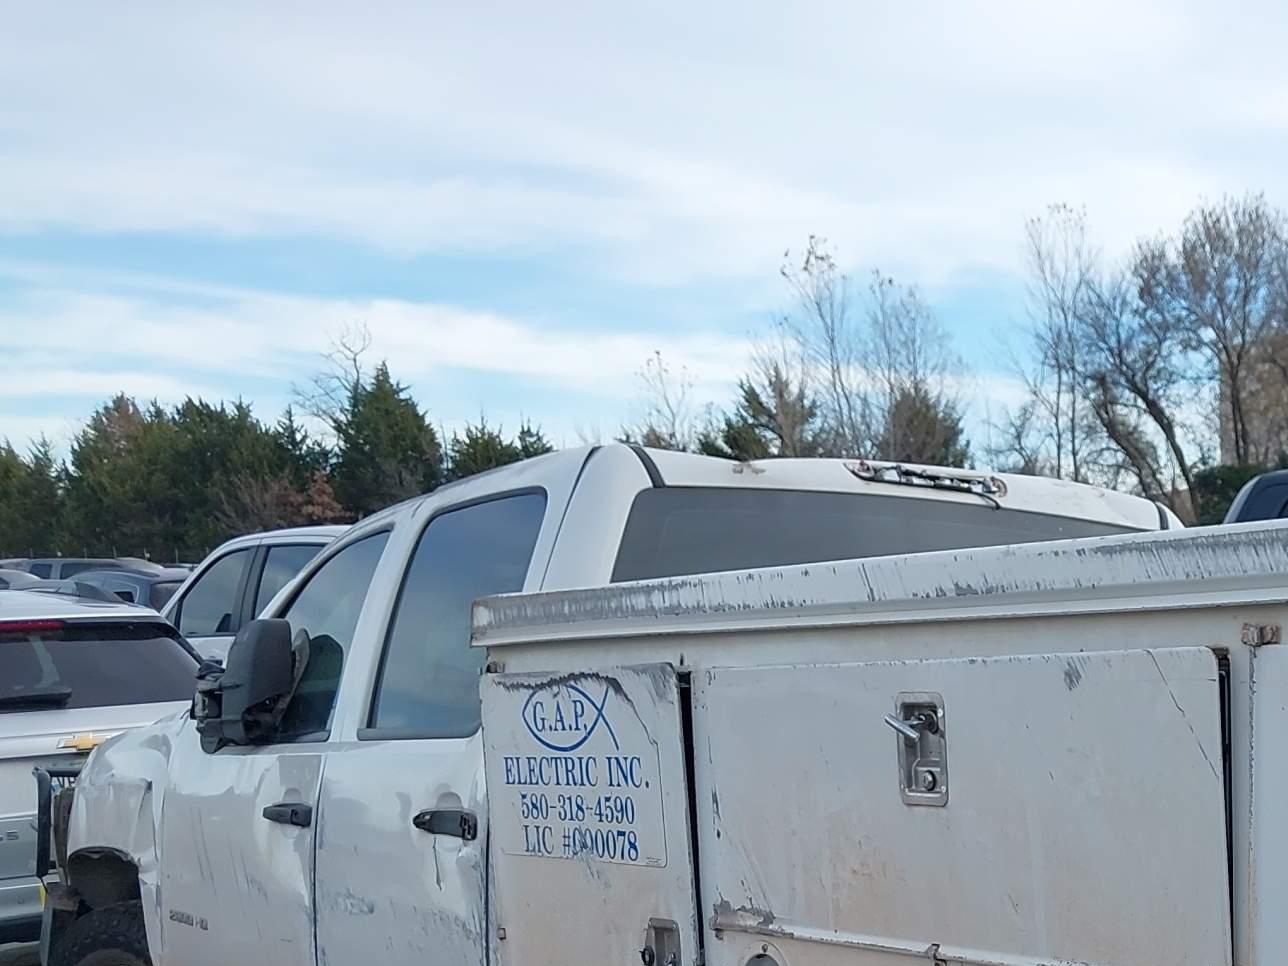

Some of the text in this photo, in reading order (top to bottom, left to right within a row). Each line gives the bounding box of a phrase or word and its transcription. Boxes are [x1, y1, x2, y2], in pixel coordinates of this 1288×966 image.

[533, 700, 587, 732] G.A.P.
[504, 756, 650, 789] ELECTRIC INC.
[521, 791, 635, 825] 580-318-4590
[523, 825, 554, 855] LIC
